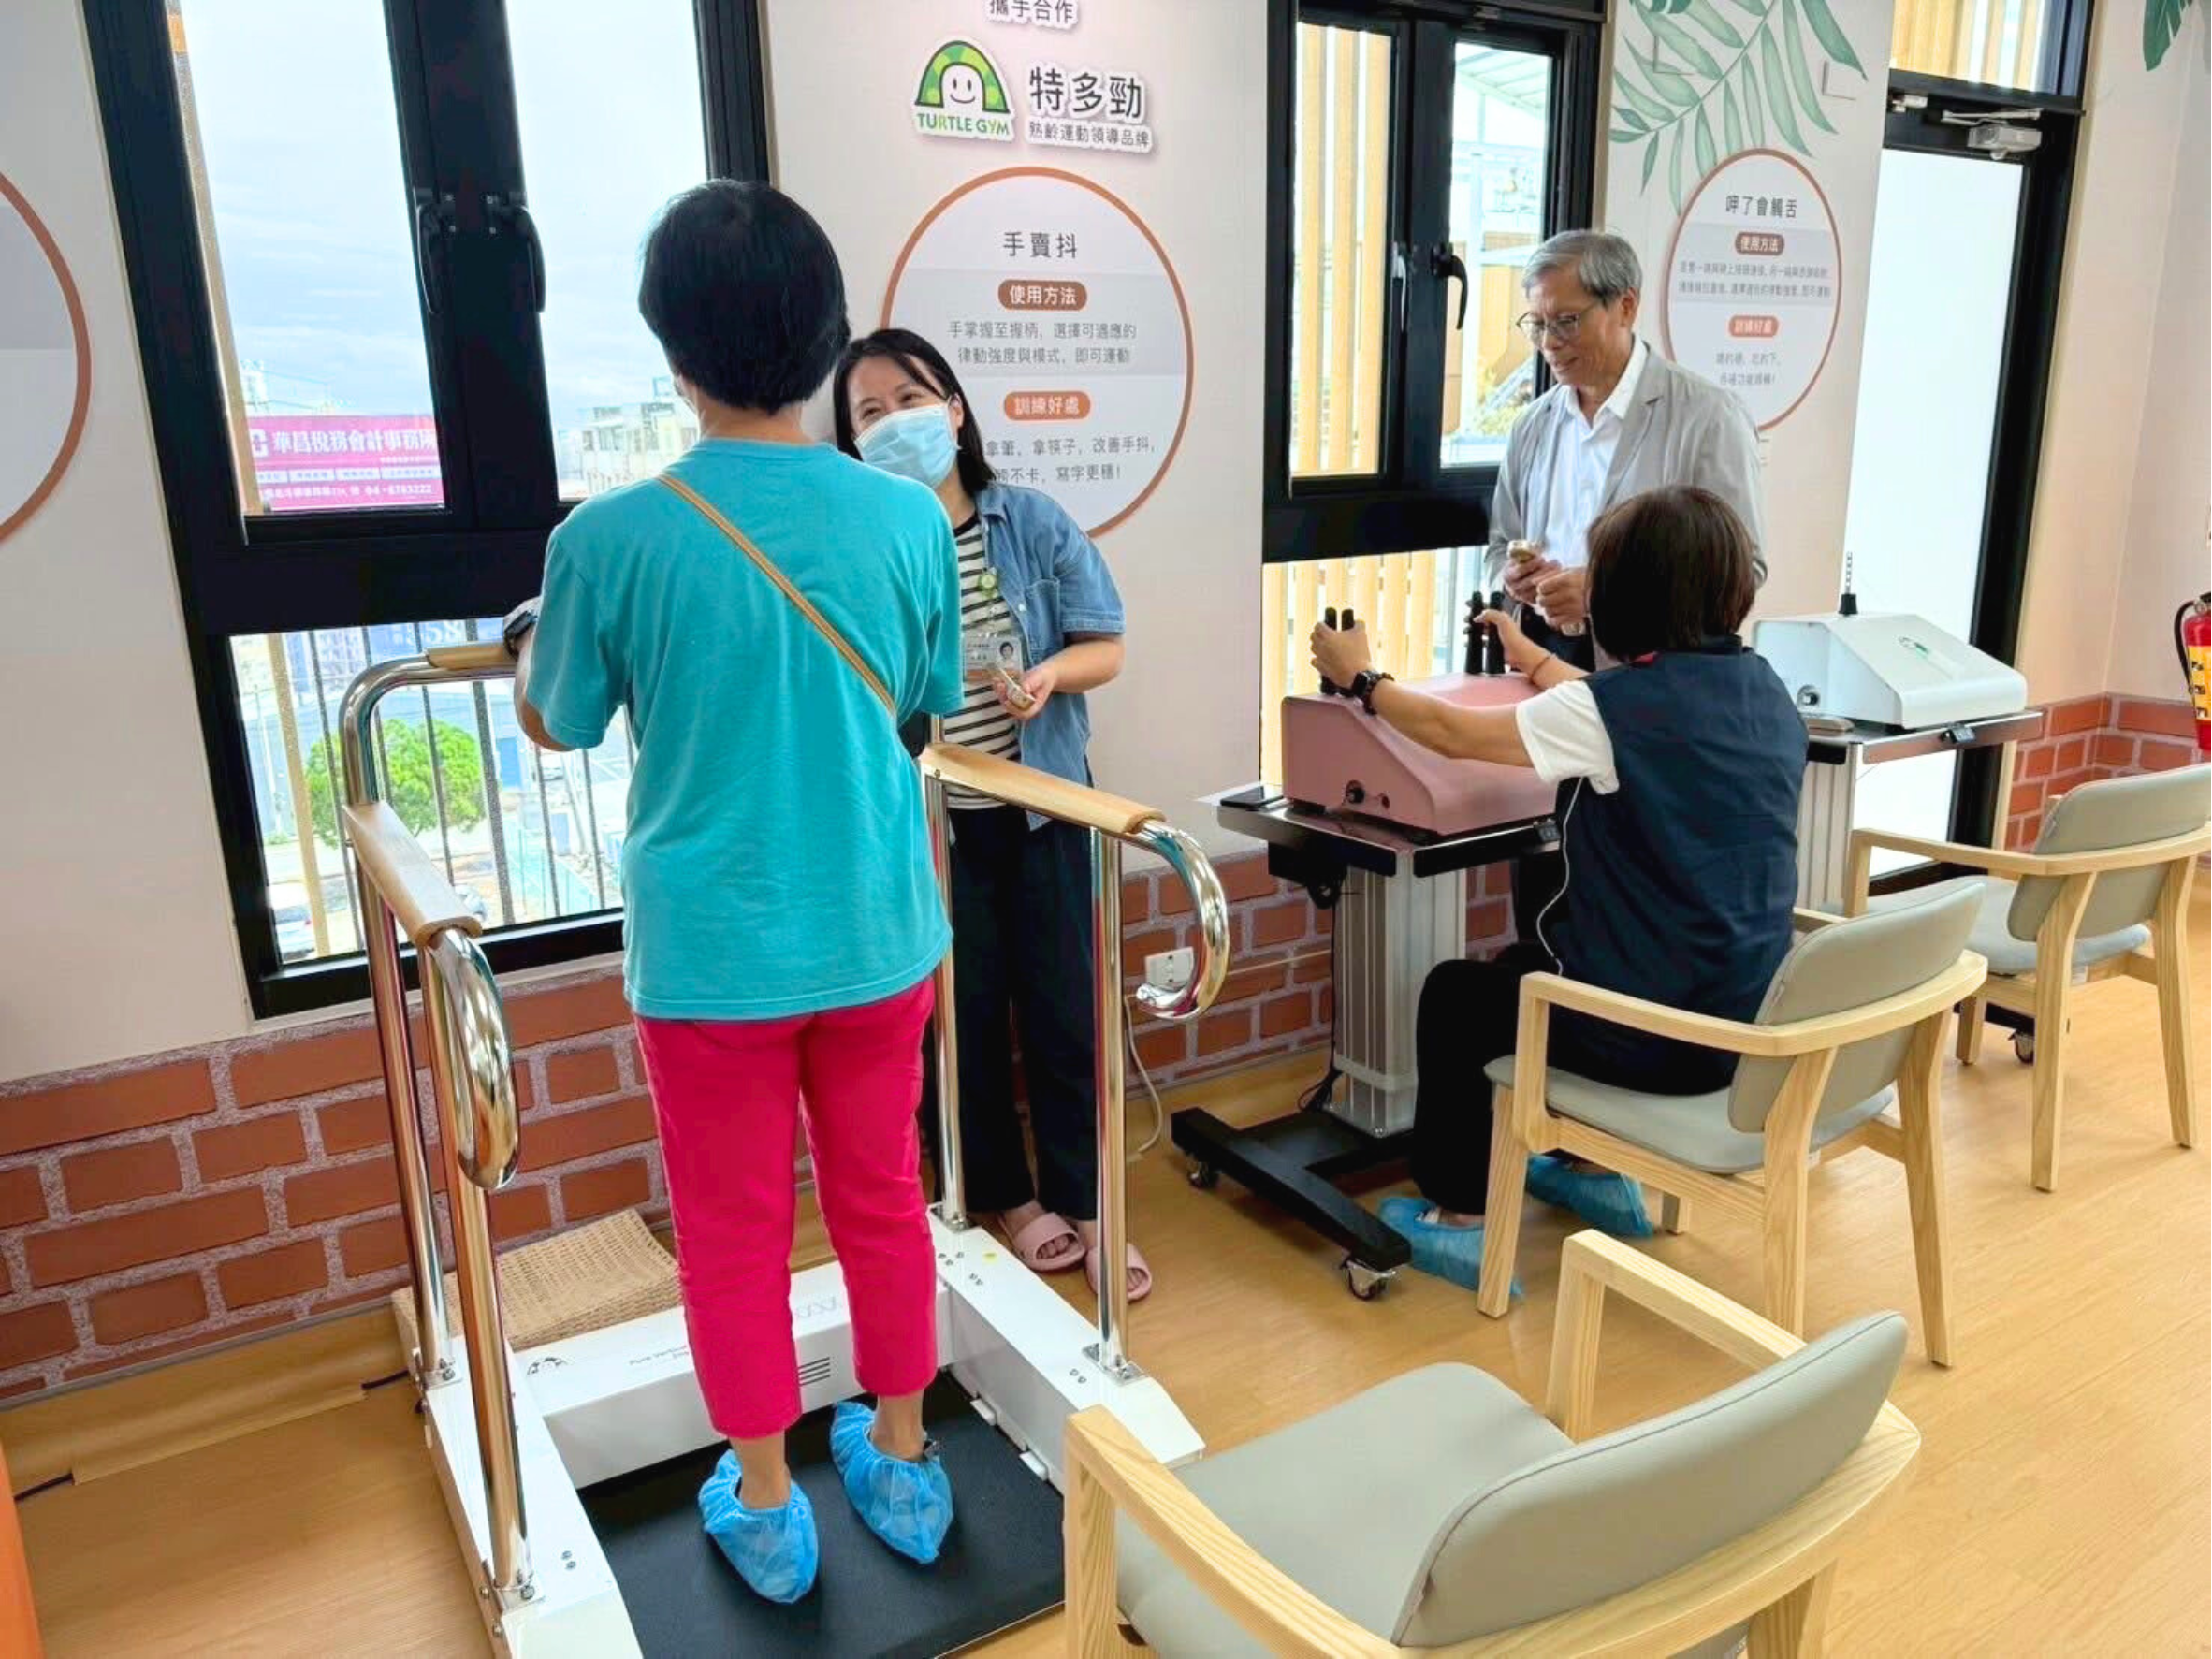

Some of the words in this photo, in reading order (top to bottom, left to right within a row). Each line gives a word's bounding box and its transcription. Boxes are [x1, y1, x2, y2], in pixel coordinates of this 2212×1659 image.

[989, 0, 1073, 23] 攜手合作
[1029, 66, 1142, 119] 特多勁
[917, 112, 972, 133] TURTLE
[977, 118, 1011, 136] GYM
[1029, 121, 1150, 148] 熟齡運動領導品牌
[1002, 232, 1078, 258] 手賣抖
[1009, 285, 1078, 306] 使用方法
[1014, 396, 1080, 415] 訓練好處
